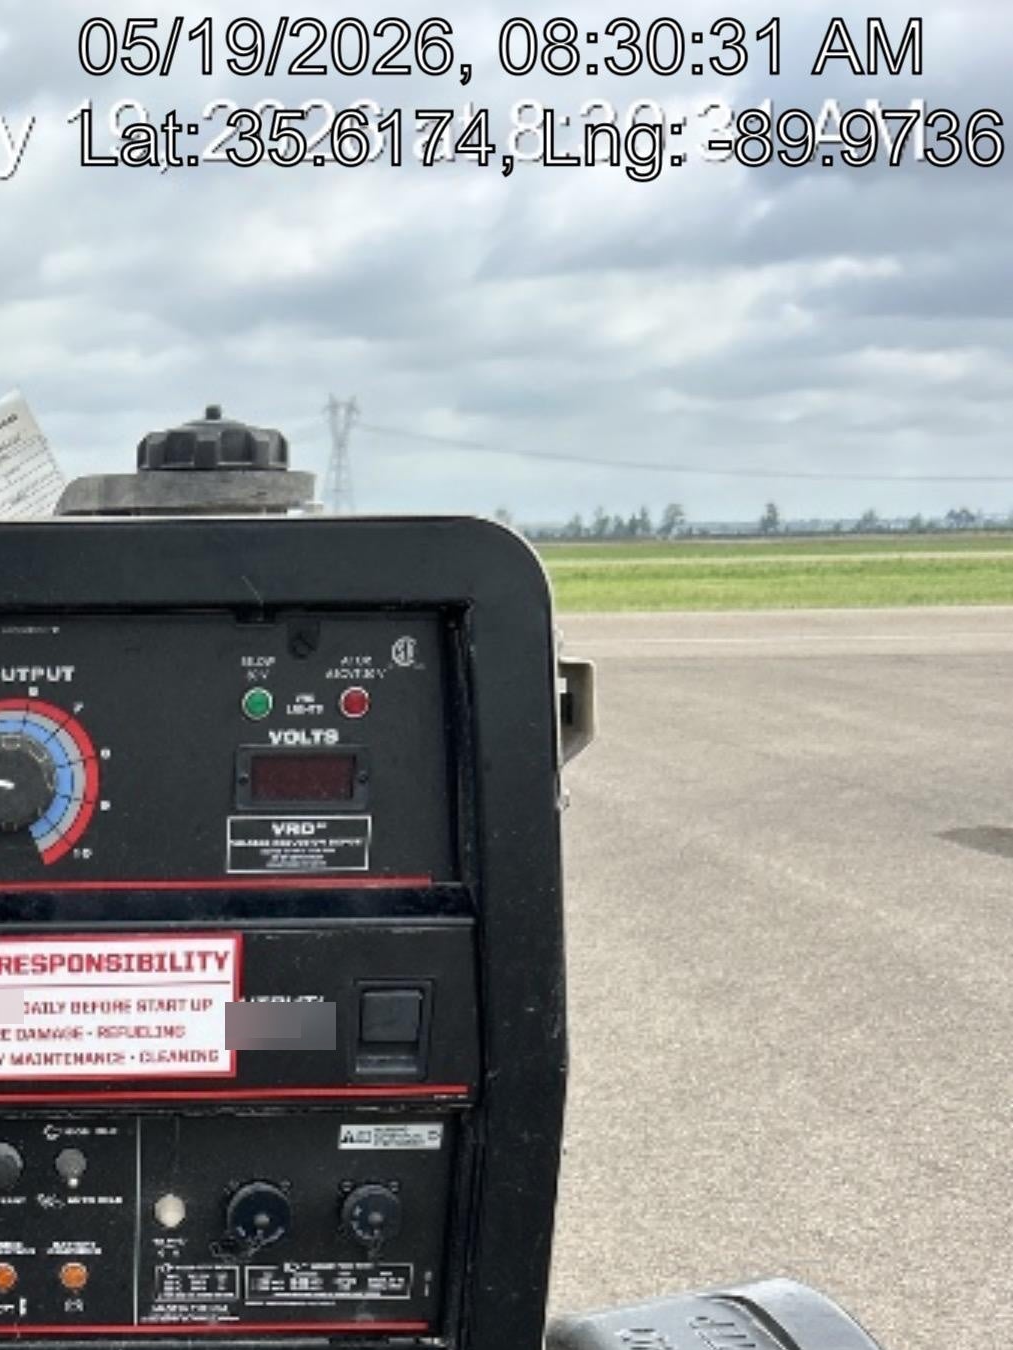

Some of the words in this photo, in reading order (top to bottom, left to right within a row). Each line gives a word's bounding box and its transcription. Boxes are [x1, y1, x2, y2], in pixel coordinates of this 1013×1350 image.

[268, 729, 340, 745] VOLTS
[70, 999, 132, 1015] BEFORE
[137, 998, 188, 1013] START
[190, 998, 214, 1012] UP
[16, 1026, 84, 1042] DAMAGE
[97, 1024, 187, 1040] REFUELING
[10, 1050, 126, 1067] MAINTENANCE
[139, 1047, 220, 1064] CLEANING
